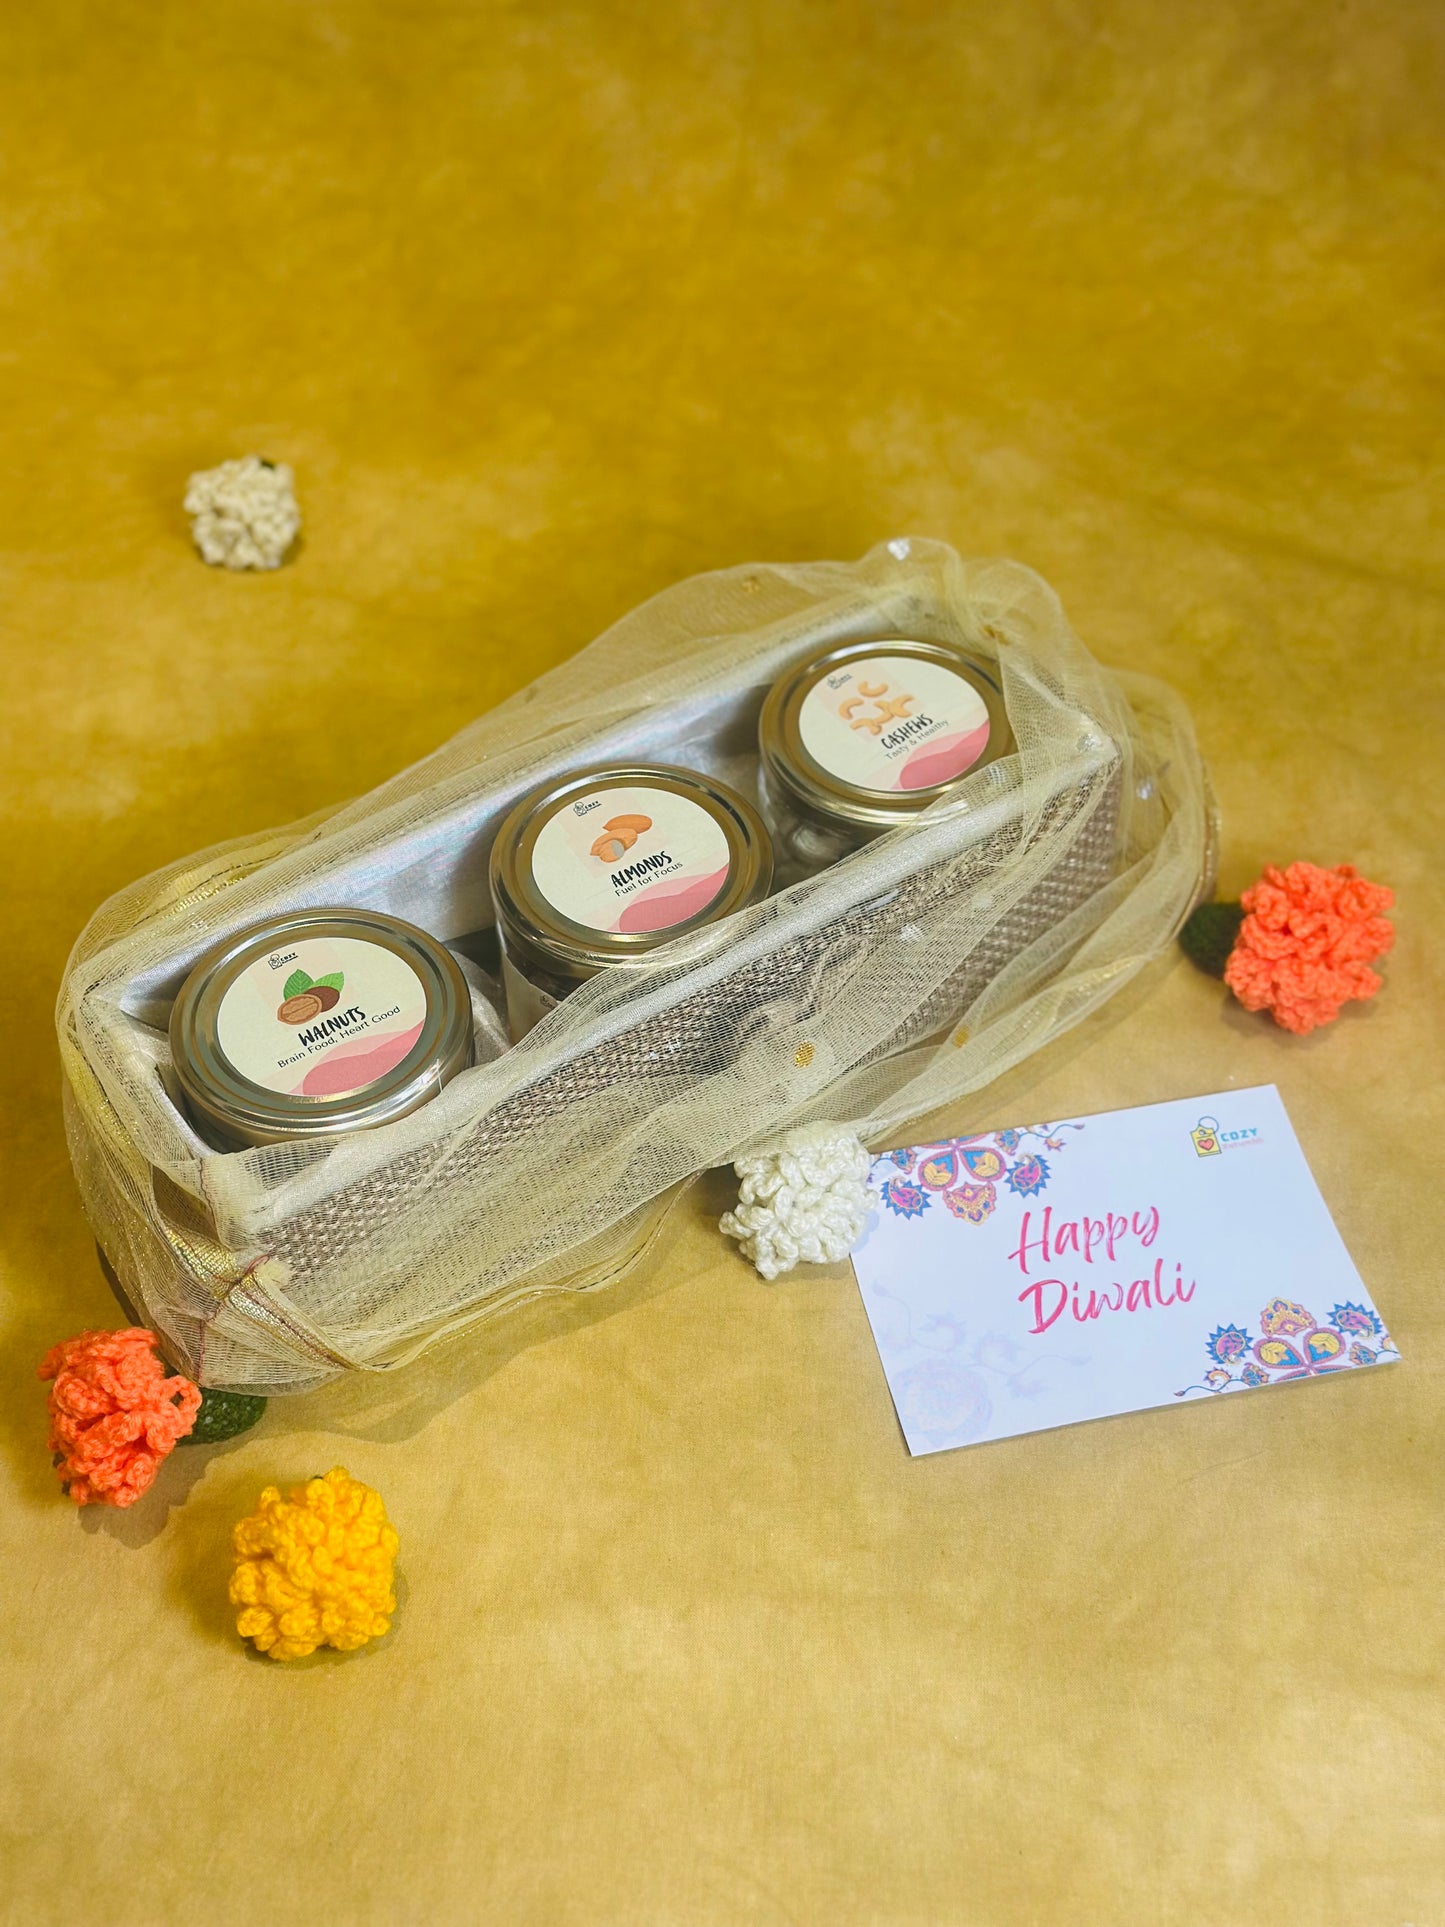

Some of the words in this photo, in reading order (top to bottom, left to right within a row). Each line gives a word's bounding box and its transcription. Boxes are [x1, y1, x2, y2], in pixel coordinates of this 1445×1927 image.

[880, 713, 933, 750] CASHEWS
[885, 744, 910, 760] Tasty
[908, 738, 917, 746] &
[916, 719, 949, 741] Healthy
[610, 850, 673, 888] ALMONDS
[615, 882, 637, 897] Fuel
[637, 875, 654, 886] for
[654, 861, 684, 879] Focus
[277, 1051, 306, 1069] Brain
[307, 1037, 338, 1054] Food,
[340, 1021, 371, 1039] Heart
[371, 1006, 401, 1024] Good
[298, 1006, 366, 1047] WALNUTS
[1220, 1127, 1258, 1142] COZY
[1008, 1206, 1160, 1275] Happy
[1018, 1258, 1196, 1334] Diwali
